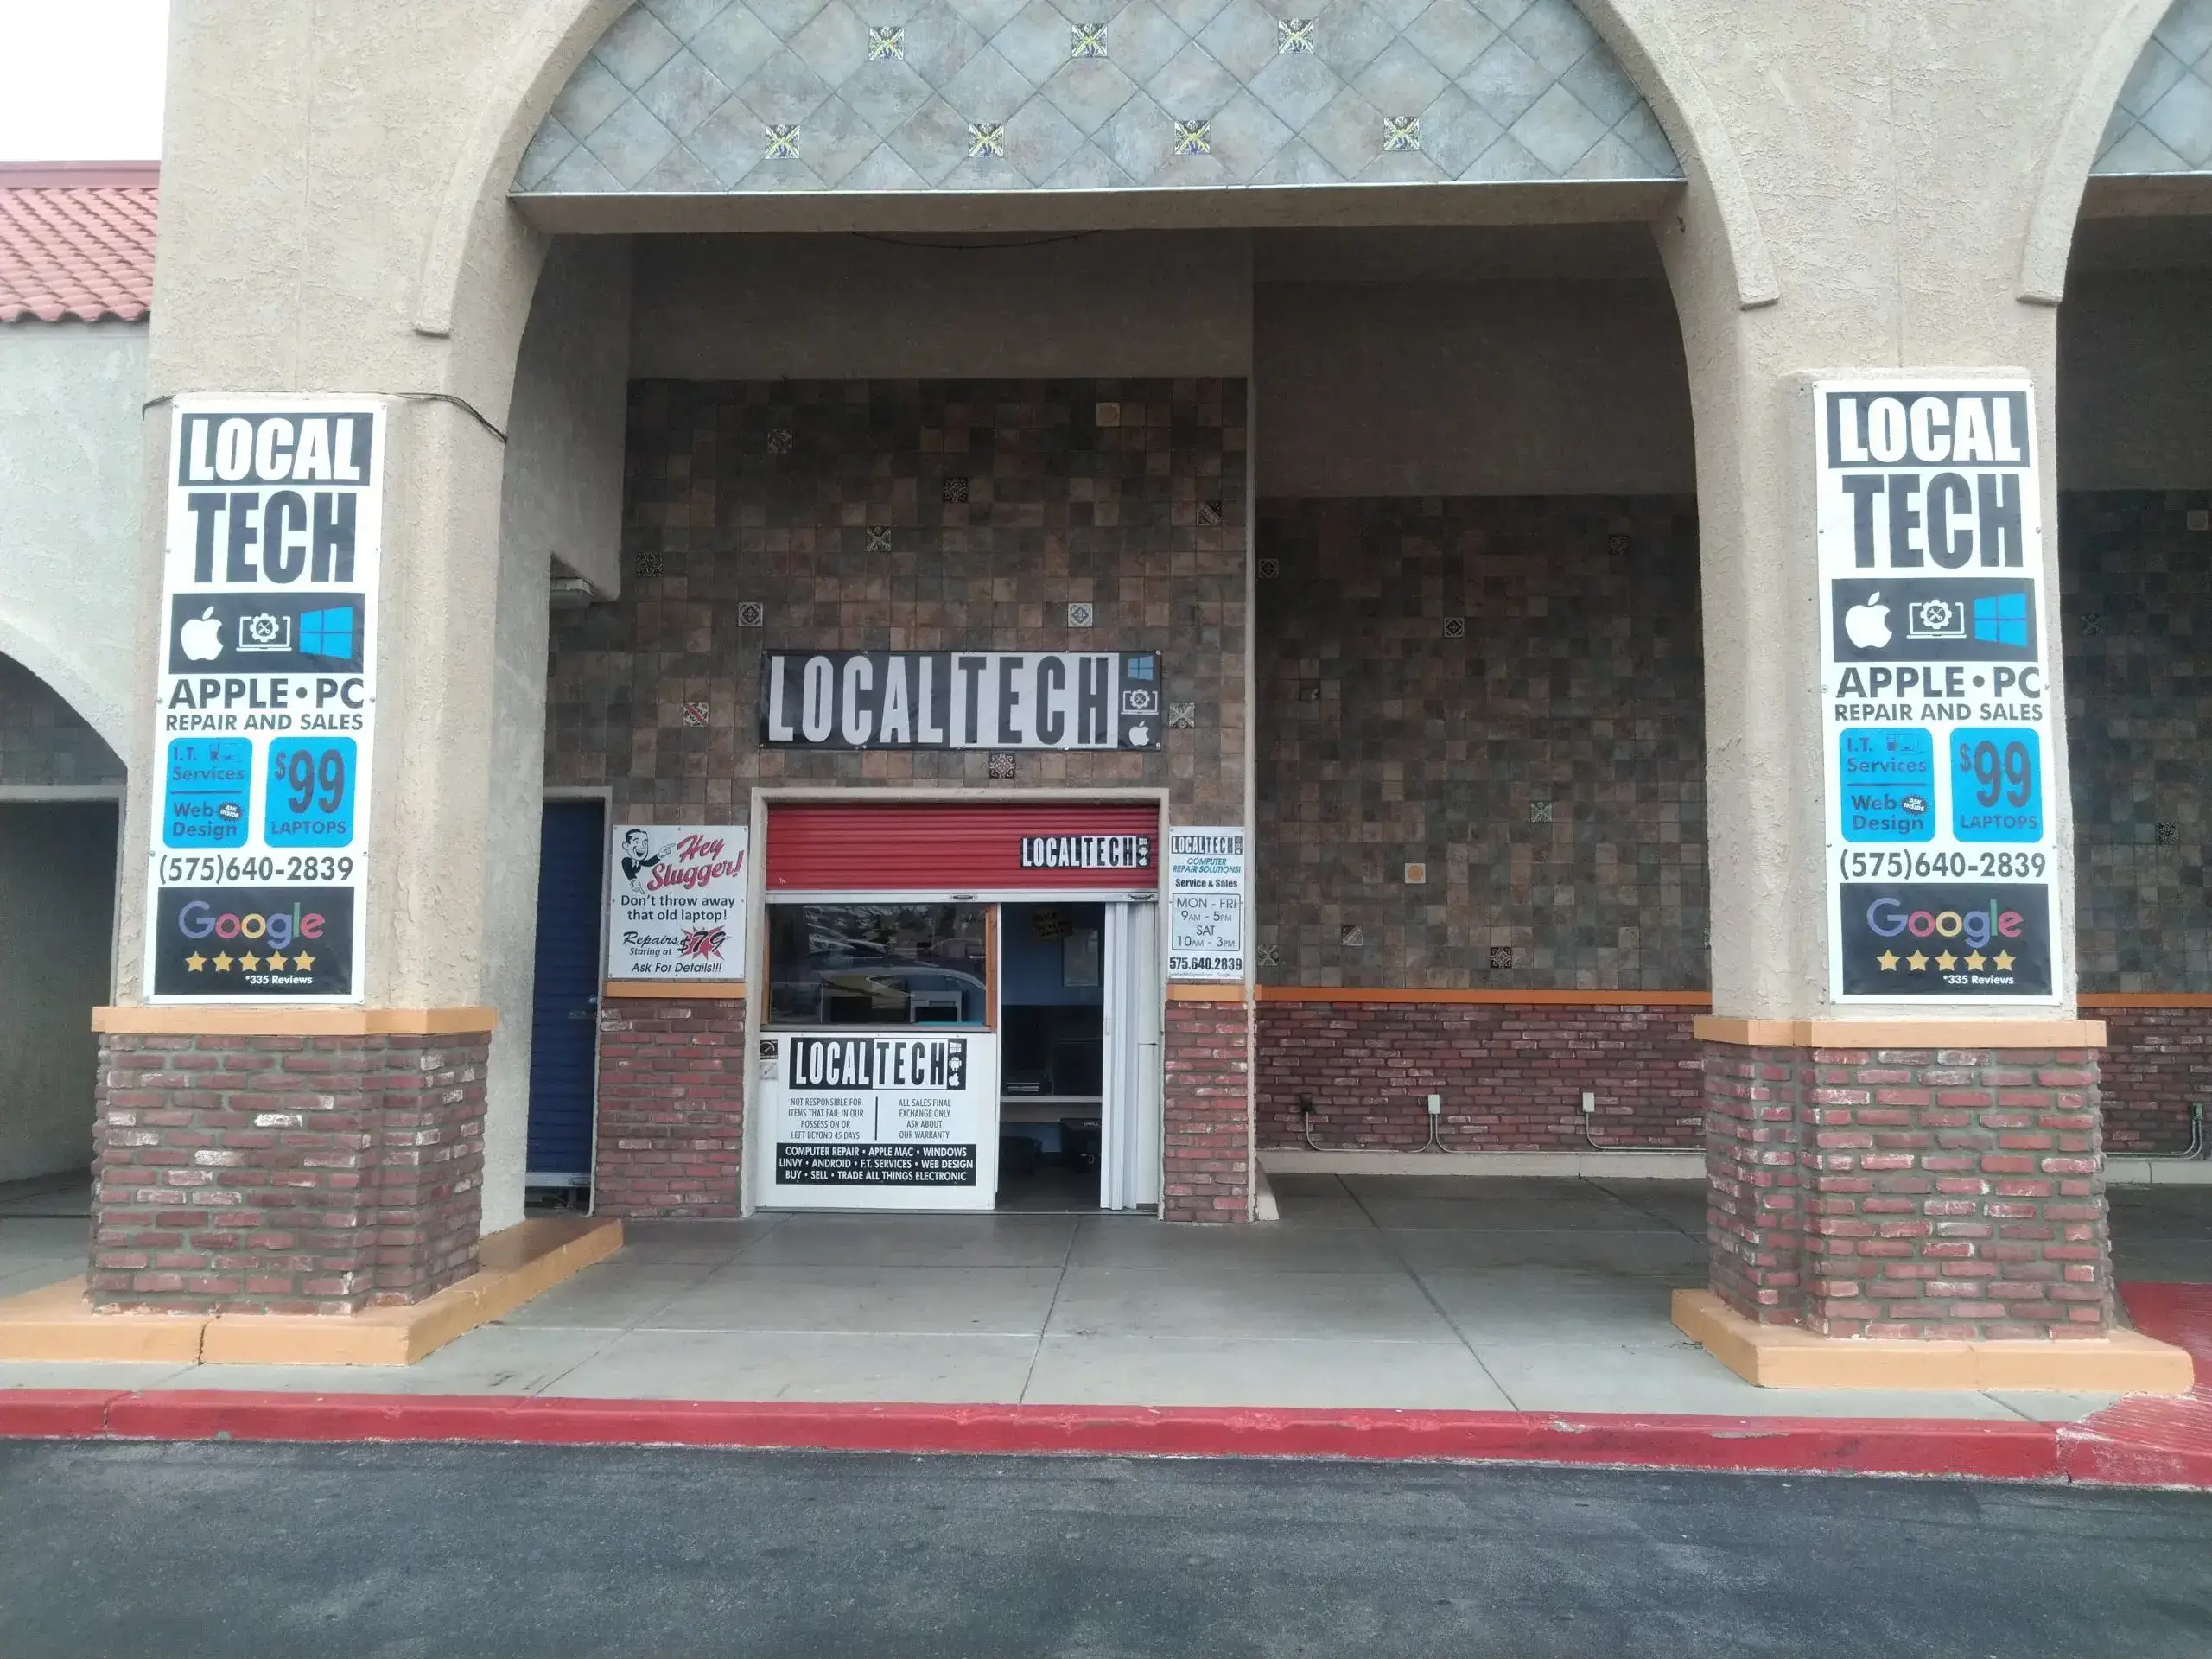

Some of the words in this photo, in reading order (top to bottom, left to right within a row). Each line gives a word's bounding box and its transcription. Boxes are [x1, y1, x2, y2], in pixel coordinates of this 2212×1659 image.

[1839, 397, 2021, 462] LOCAL
[189, 418, 360, 480] LOCAL
[1842, 472, 2023, 569] TECH
[188, 490, 357, 583] TECH
[1836, 667, 1965, 698] APPLE
[1993, 666, 2041, 698] PC
[168, 678, 288, 709] APPLE
[316, 677, 364, 709] PC
[1835, 703, 1913, 721] REPAIR
[1920, 703, 1971, 721] AND
[1980, 702, 2043, 721] SALES
[166, 715, 235, 731] REPAIR
[244, 715, 292, 730] AND
[301, 714, 363, 730] SALES
[1847, 737, 1872, 752] I.T.
[174, 747, 197, 760] I.T.
[1847, 757, 1926, 772] Services
[173, 766, 245, 780] Services
[1851, 793, 1897, 810] Web
[1904, 803, 1924, 811] INSIDE
[173, 802, 213, 817] Web
[220, 809, 239, 818] INSIDE
[271, 821, 346, 835] LAPTOPS
[1853, 814, 1923, 835] Design
[1961, 814, 2037, 830] LAPTOPS
[173, 821, 238, 840] Design
[677, 834, 726, 863] Hey
[159, 854, 353, 884] (575)640-2839
[647, 850, 744, 891] Slugger!
[1840, 849, 2046, 880] (575)640-2839
[1176, 879, 1206, 887] Service
[659, 894, 697, 906] throw
[702, 897, 735, 908] away
[1177, 898, 1207, 908] MON
[1220, 899, 1236, 908] FRI
[627, 910, 653, 920] that
[658, 909, 677, 920] old
[681, 909, 727, 922] laptop!
[1181, 911, 1200, 921] 9AM
[1213, 911, 1232, 921] 5PM
[178, 900, 325, 950] Google
[1866, 897, 2024, 949] Google
[1197, 925, 1215, 936] SAT
[622, 931, 677, 948] Repairs
[1178, 936, 1204, 946] 10AM
[629, 947, 660, 957] Staring
[632, 963, 652, 972] Ask
[655, 963, 671, 972] For
[675, 963, 722, 972] Details!!!
[1169, 957, 1243, 970] 575.640.2839
[272, 975, 313, 984] Reviews
[1971, 974, 2014, 984] Reviews
[788, 1109, 807, 1117] ITEMS
[809, 1109, 824, 1117] THAT
[826, 1109, 840, 1117] FAIL
[841, 1109, 849, 1117] IN
[849, 1109, 864, 1117] OUR
[801, 1120, 840, 1128] POSSESSION
[841, 1120, 851, 1128] OR
[906, 1120, 919, 1128] ASK
[920, 1120, 943, 1128] ABOUT
[785, 1147, 830, 1156] COMPUTER
[832, 1147, 859, 1156] REPAIR
[868, 1147, 892, 1156] APPLE
[894, 1147, 913, 1156] MAC
[923, 1147, 967, 1156] WINDOWS
[811, 1159, 851, 1168] ANDROID
[874, 1159, 912, 1168] SERVICES
[921, 1159, 939, 1168] WEB
[942, 1159, 973, 1168] DESIGN
[785, 1171, 802, 1180] BUY
[810, 1171, 828, 1180] SELL
[837, 1171, 863, 1180] TRADE
[866, 1171, 880, 1180] ALL
[882, 1171, 913, 1180] THINGS
[915, 1171, 967, 1180] ELECTRONIC
